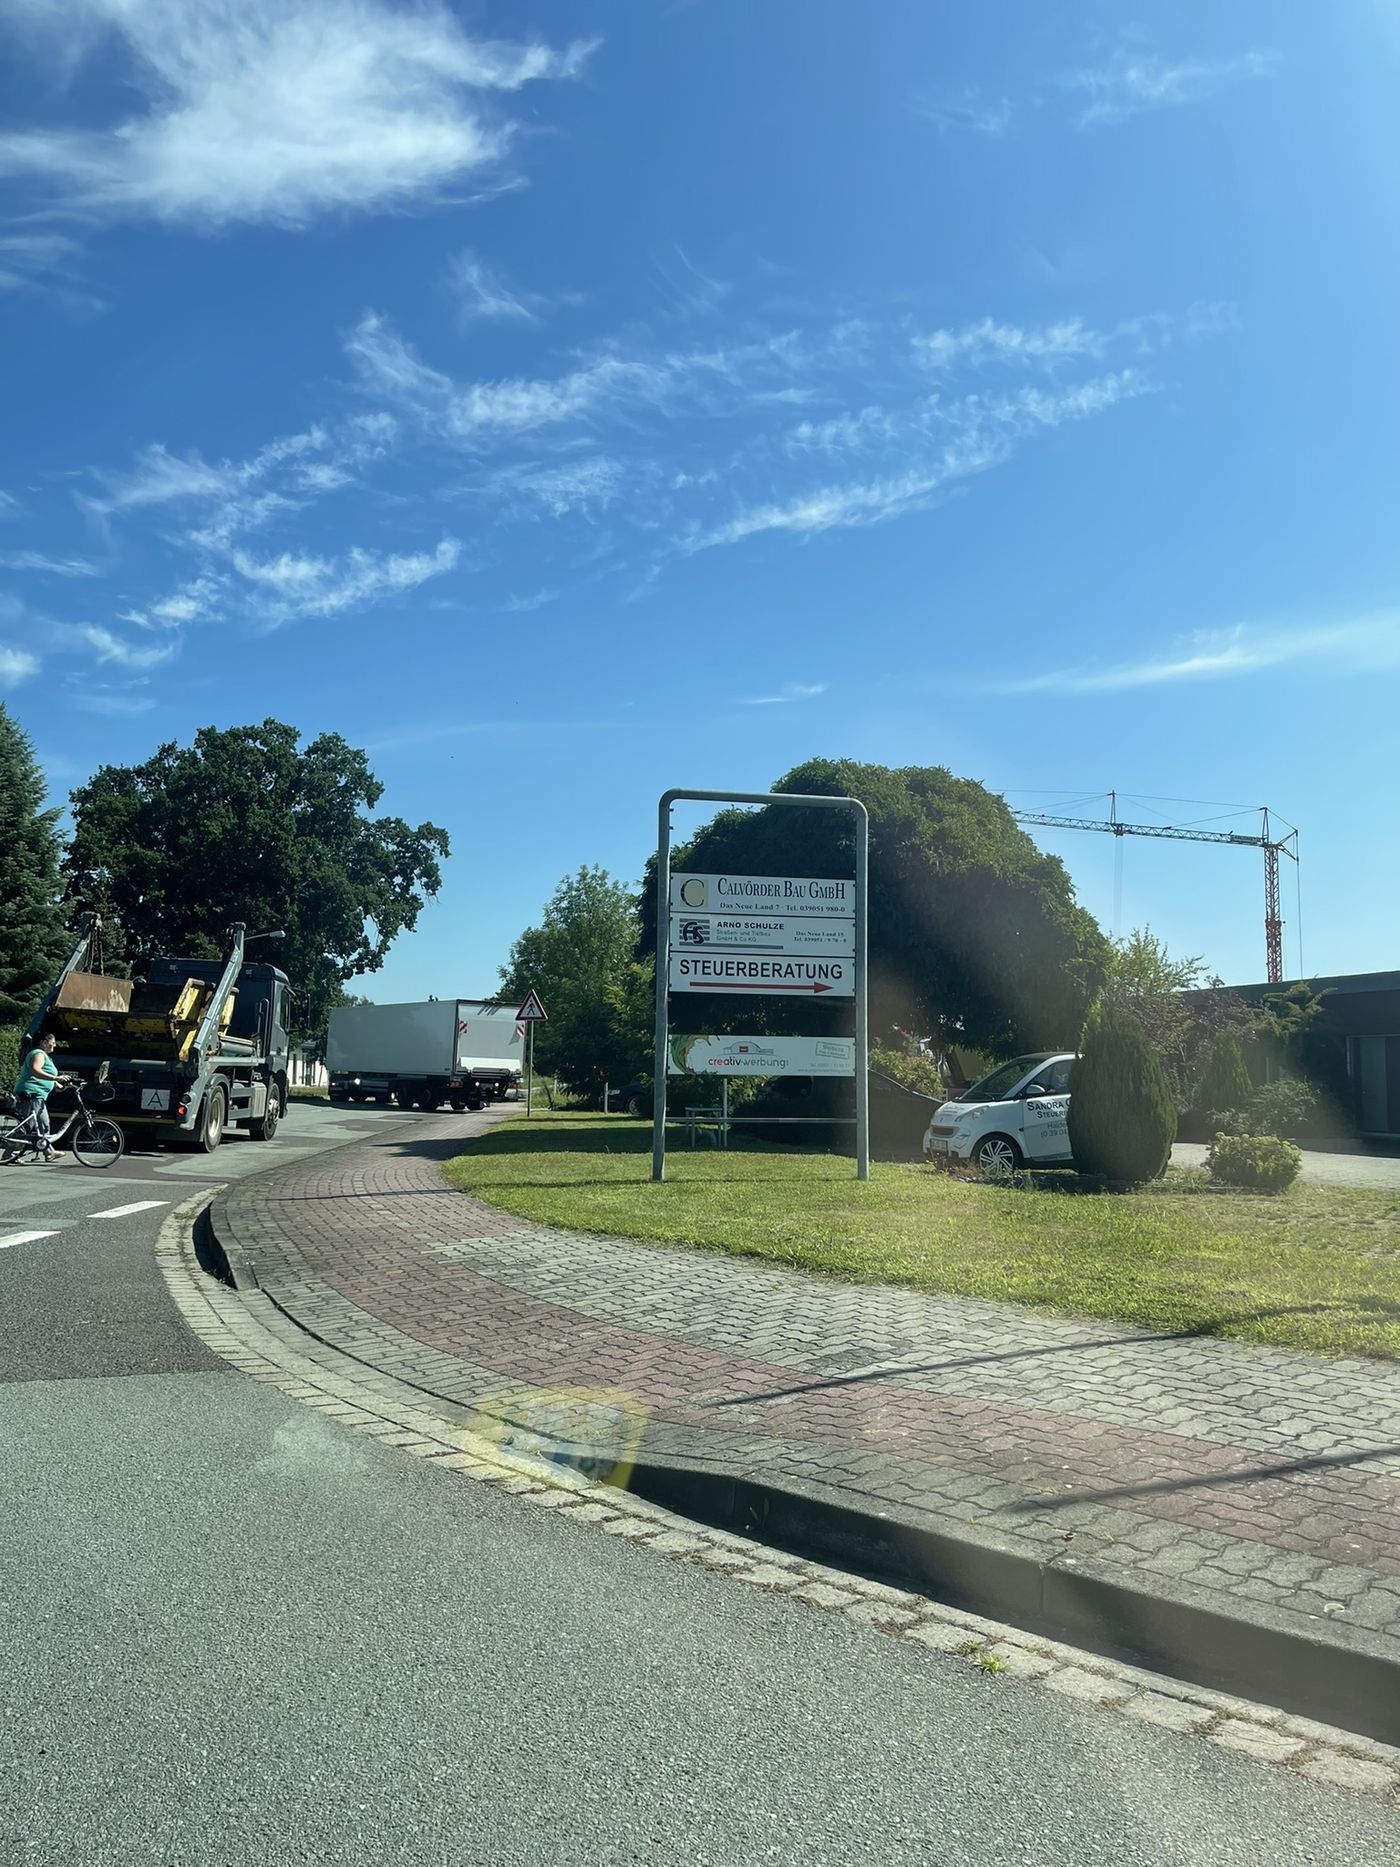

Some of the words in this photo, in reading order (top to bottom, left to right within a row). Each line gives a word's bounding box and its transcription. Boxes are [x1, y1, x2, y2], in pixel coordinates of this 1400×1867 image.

[735, 902, 753, 910] Neue
[717, 921, 742, 929] ARNO
[744, 922, 785, 931] SCHULZE
[679, 958, 843, 979] STEUERBERATUNG
[147, 1089, 162, 1107] A
